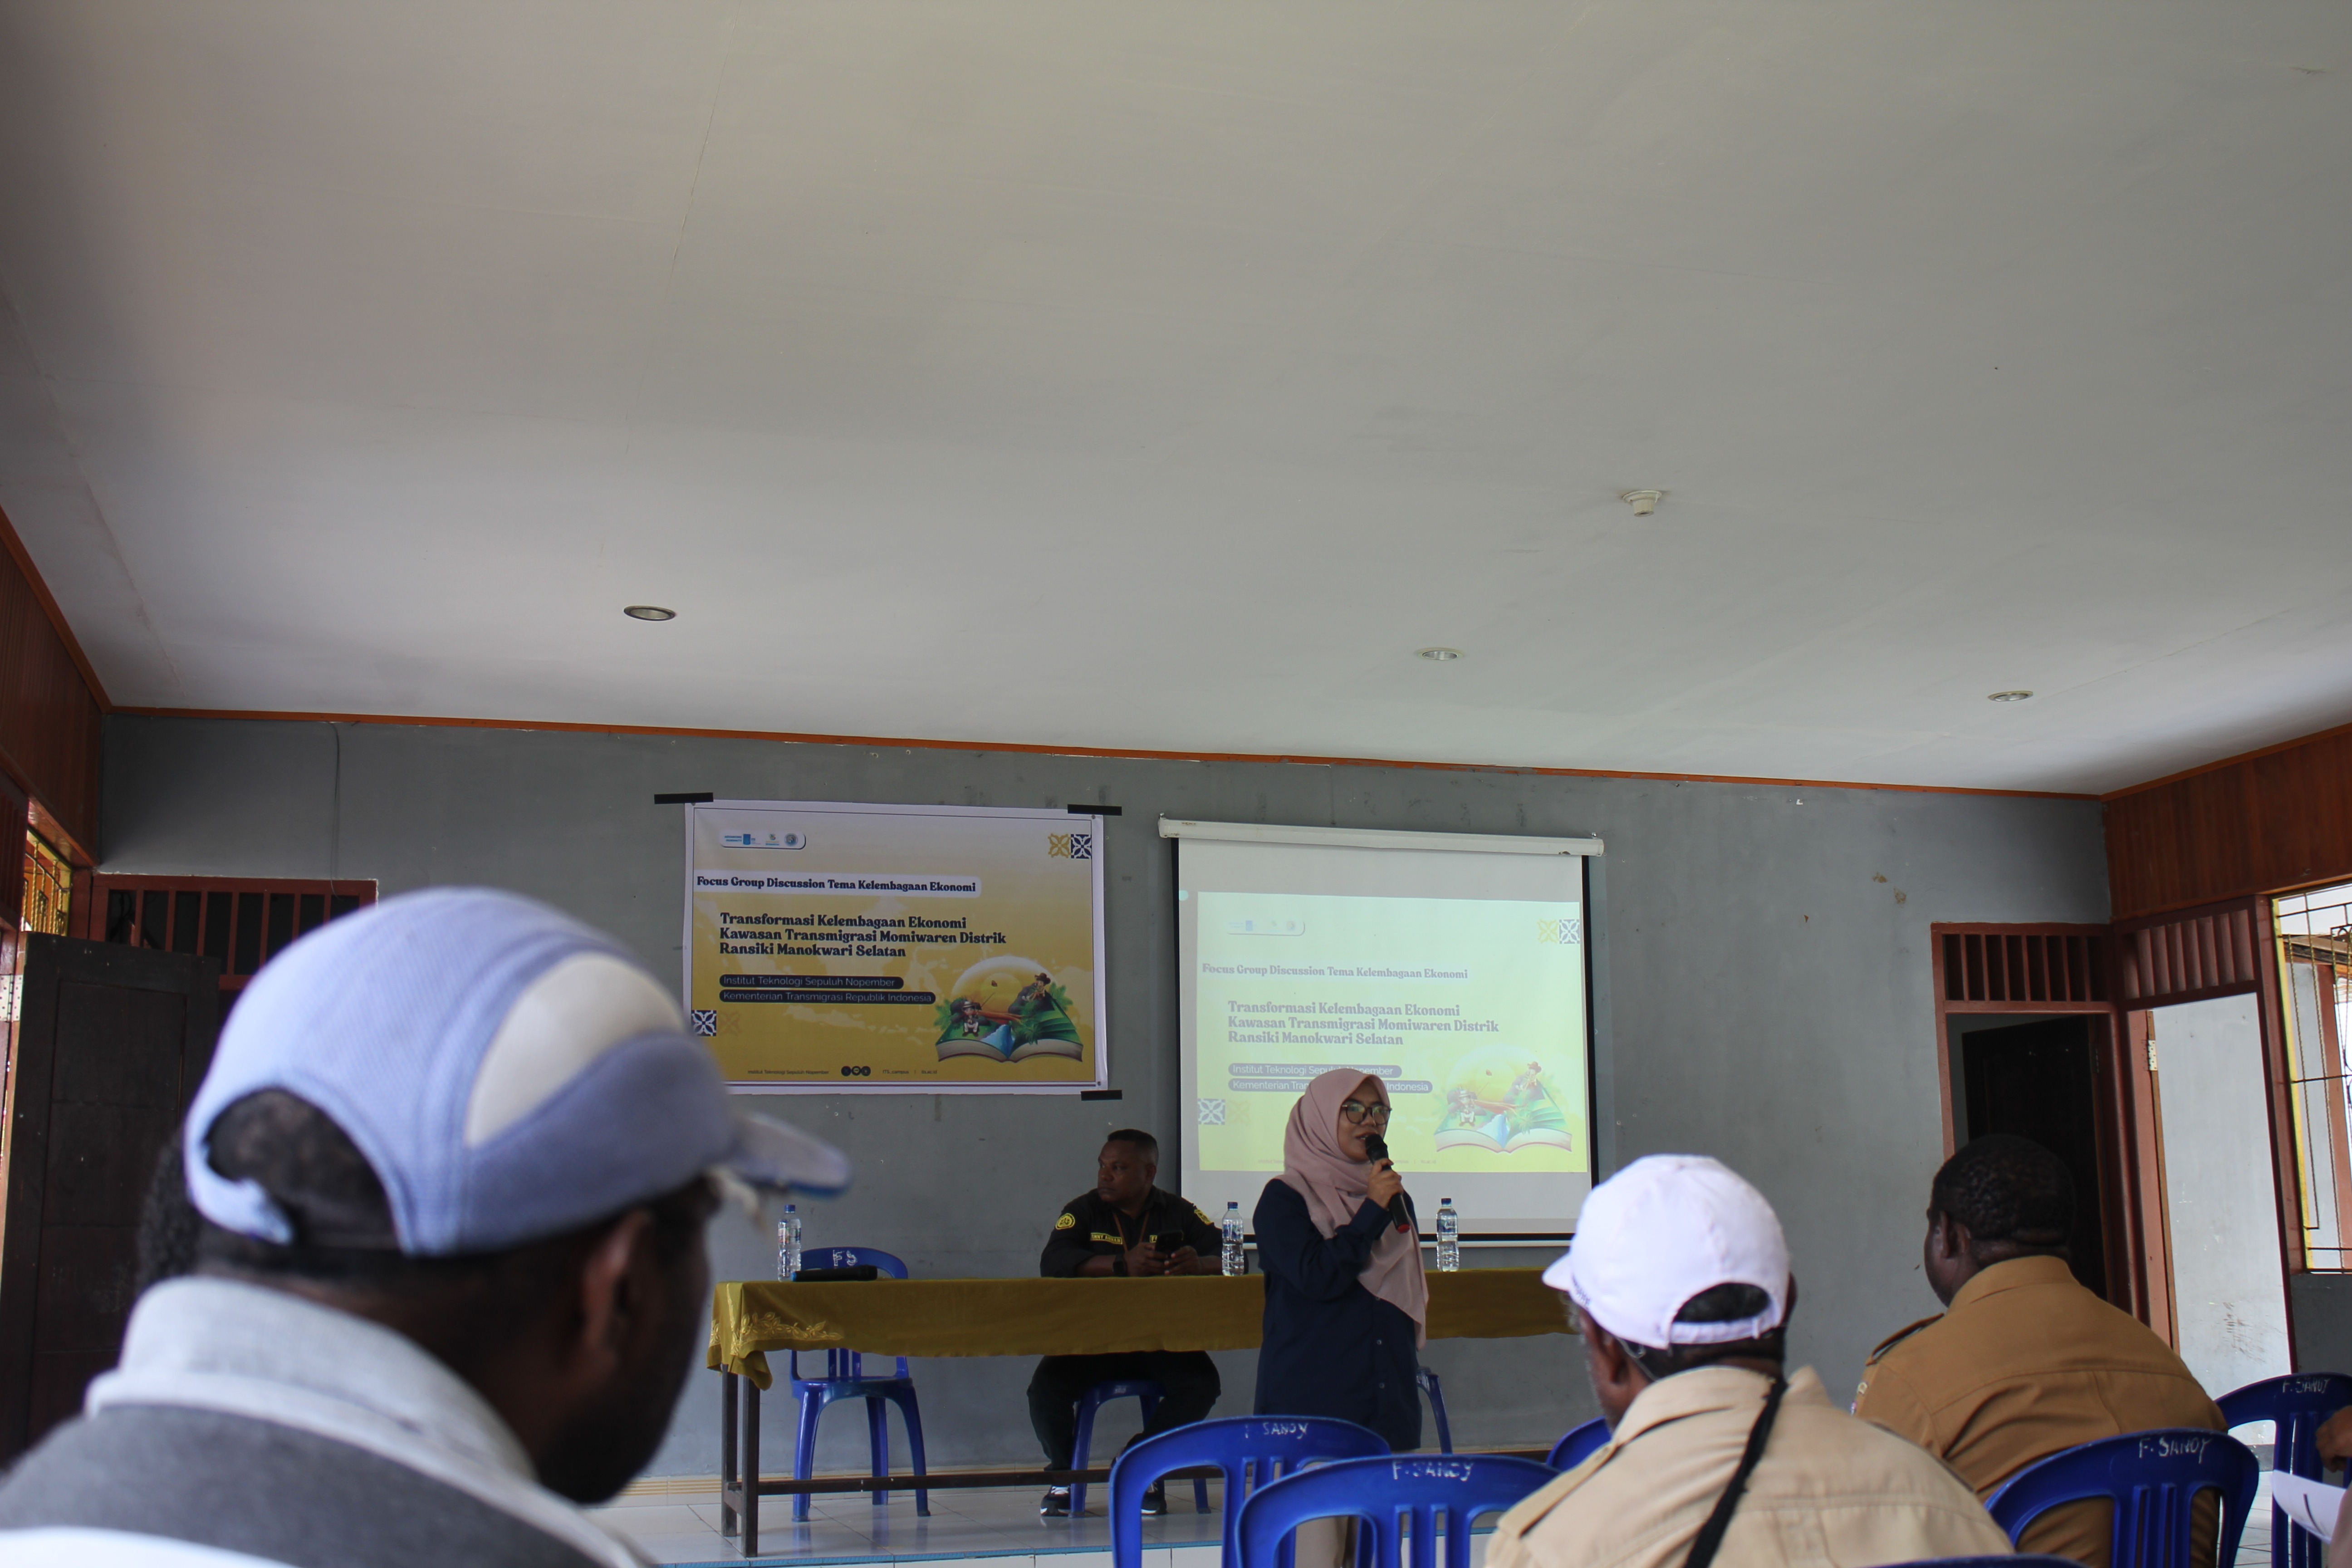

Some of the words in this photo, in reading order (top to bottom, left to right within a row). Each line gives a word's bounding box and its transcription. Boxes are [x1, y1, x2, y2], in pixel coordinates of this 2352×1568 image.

[697, 876, 729, 886] Focus
[731, 877, 765, 889] Group
[766, 877, 826, 889] Discussion
[828, 879, 856, 889] Tema
[858, 880, 928, 892] Kelembagaan
[930, 882, 976, 892] Ekonomi
[720, 912, 814, 926] Transformasi
[817, 914, 906, 929] Kelembagaan
[908, 916, 966, 929] Ekonomi
[720, 927, 782, 940] Kawasan
[785, 928, 877, 943] Transmigrasi
[879, 930, 957, 943] Momiwaren
[960, 931, 1007, 944] Distrik
[719, 942, 774, 955] Ransiki
[777, 943, 853, 956] Manokwari
[856, 944, 906, 957] Selatan
[1202, 963, 1235, 974] Focus
[1236, 965, 1268, 976] Group
[1269, 965, 1325, 976] Discussion
[1327, 966, 1354, 976] Tema
[1356, 967, 1422, 979] Kelembagaan
[1424, 968, 1468, 979] Ekonomi
[724, 976, 755, 985] Institut
[758, 976, 803, 988] Teknologi
[805, 977, 843, 988] Sepuluh
[846, 978, 895, 989] Nopember
[724, 991, 783, 1000] Kementerian
[785, 992, 843, 1003] Transmigrasi
[845, 993, 886, 1004] Republik
[888, 993, 932, 1002] Indonesia
[1228, 1000, 1316, 1014] Transformasi
[1318, 1002, 1402, 1017] Kelembagaan
[1405, 1004, 1460, 1016] Ekonomi
[1228, 1015, 1286, 1028] Kawasan
[1288, 1016, 1375, 1031] Transmigrasi
[1378, 1019, 1451, 1031] Momiwaren
[1454, 1019, 1499, 1032] Distrik
[1228, 1030, 1279, 1043] Ransiki
[1282, 1031, 1352, 1044] Manokwari
[1356, 1032, 1404, 1045] Selatan
[1233, 1065, 1263, 1074] Institut
[1266, 1065, 1307, 1076] Teknologi
[1233, 1081, 1289, 1089] Kementerian
[1387, 1082, 1428, 1091] Indonesia
